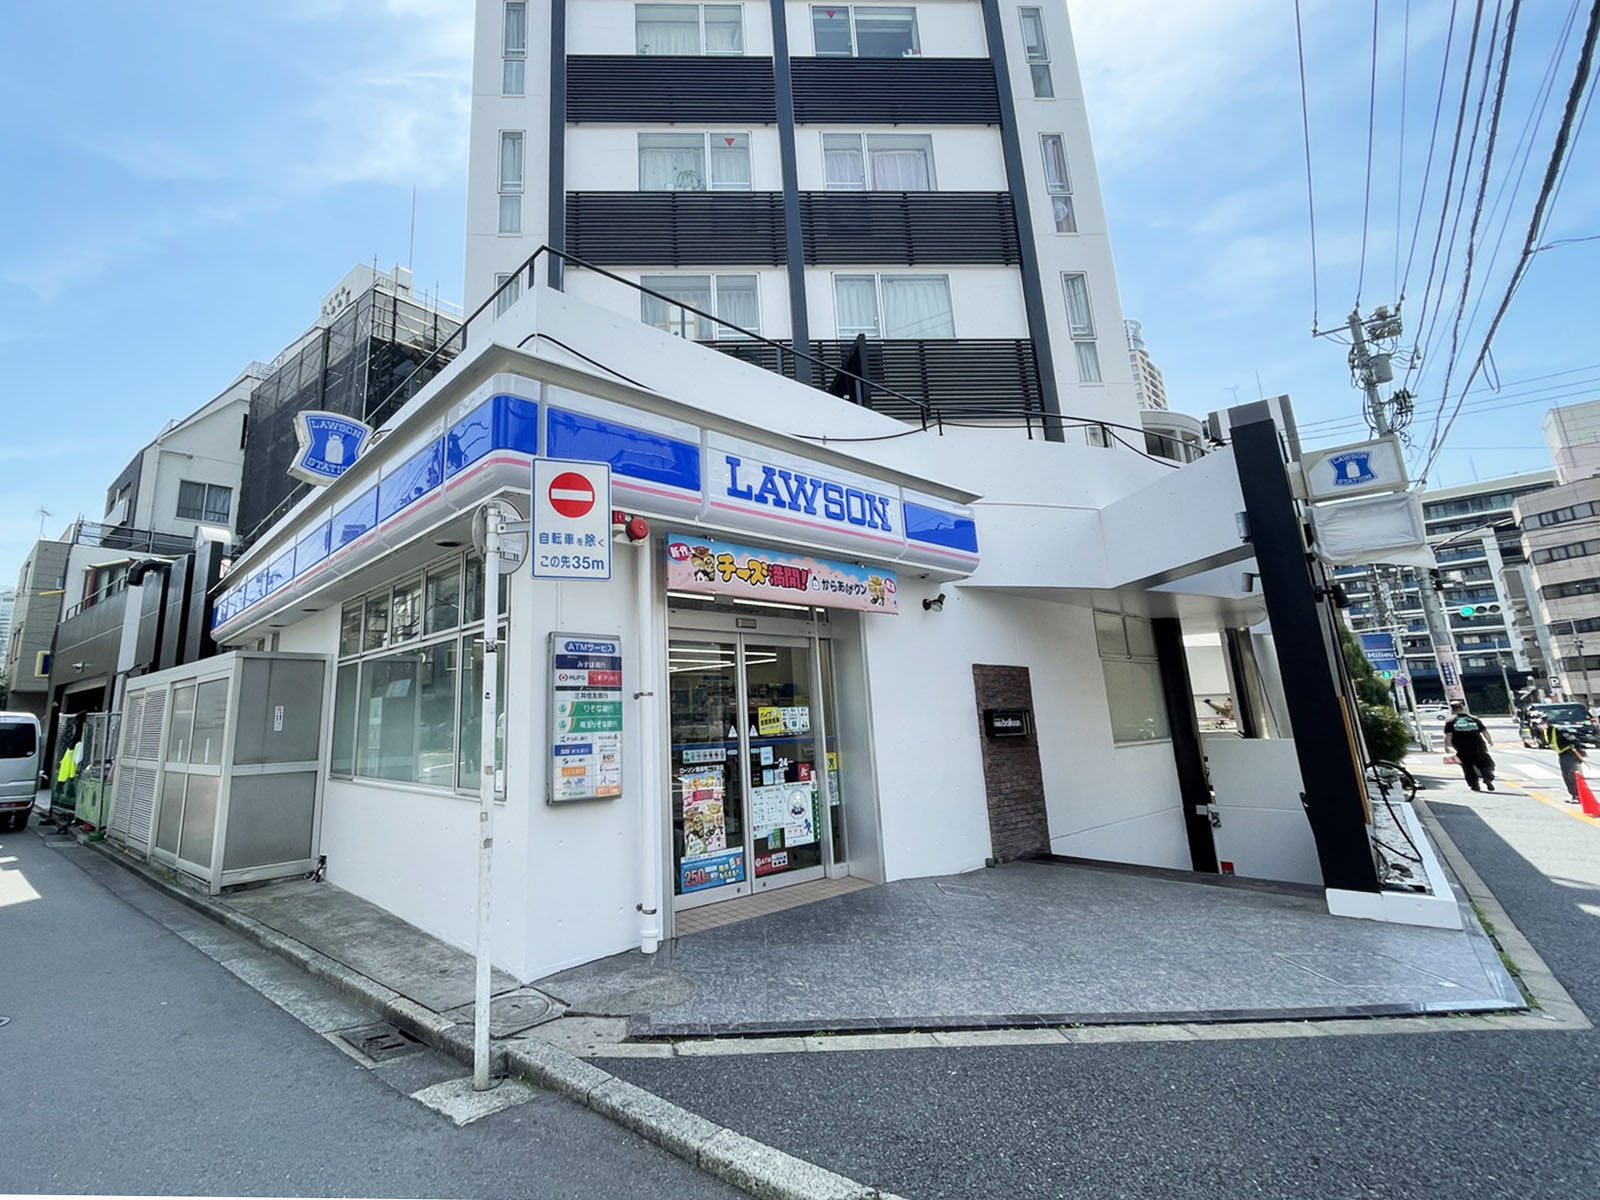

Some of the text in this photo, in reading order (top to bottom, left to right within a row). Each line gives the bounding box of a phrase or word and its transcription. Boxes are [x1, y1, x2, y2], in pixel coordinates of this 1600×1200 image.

[311, 420, 361, 438] LAWSON
[306, 457, 348, 473] STATI
[1333, 453, 1368, 464] LAWSON
[1338, 474, 1373, 485] STATION
[725, 456, 892, 532] LAWSON
[539, 532, 605, 547] 自転車を除く
[539, 555, 605, 570] この先35m
[821, 578, 868, 596] からあげクン
[567, 642, 614, 653] ATMサービス
[778, 757, 788, 767] 24
